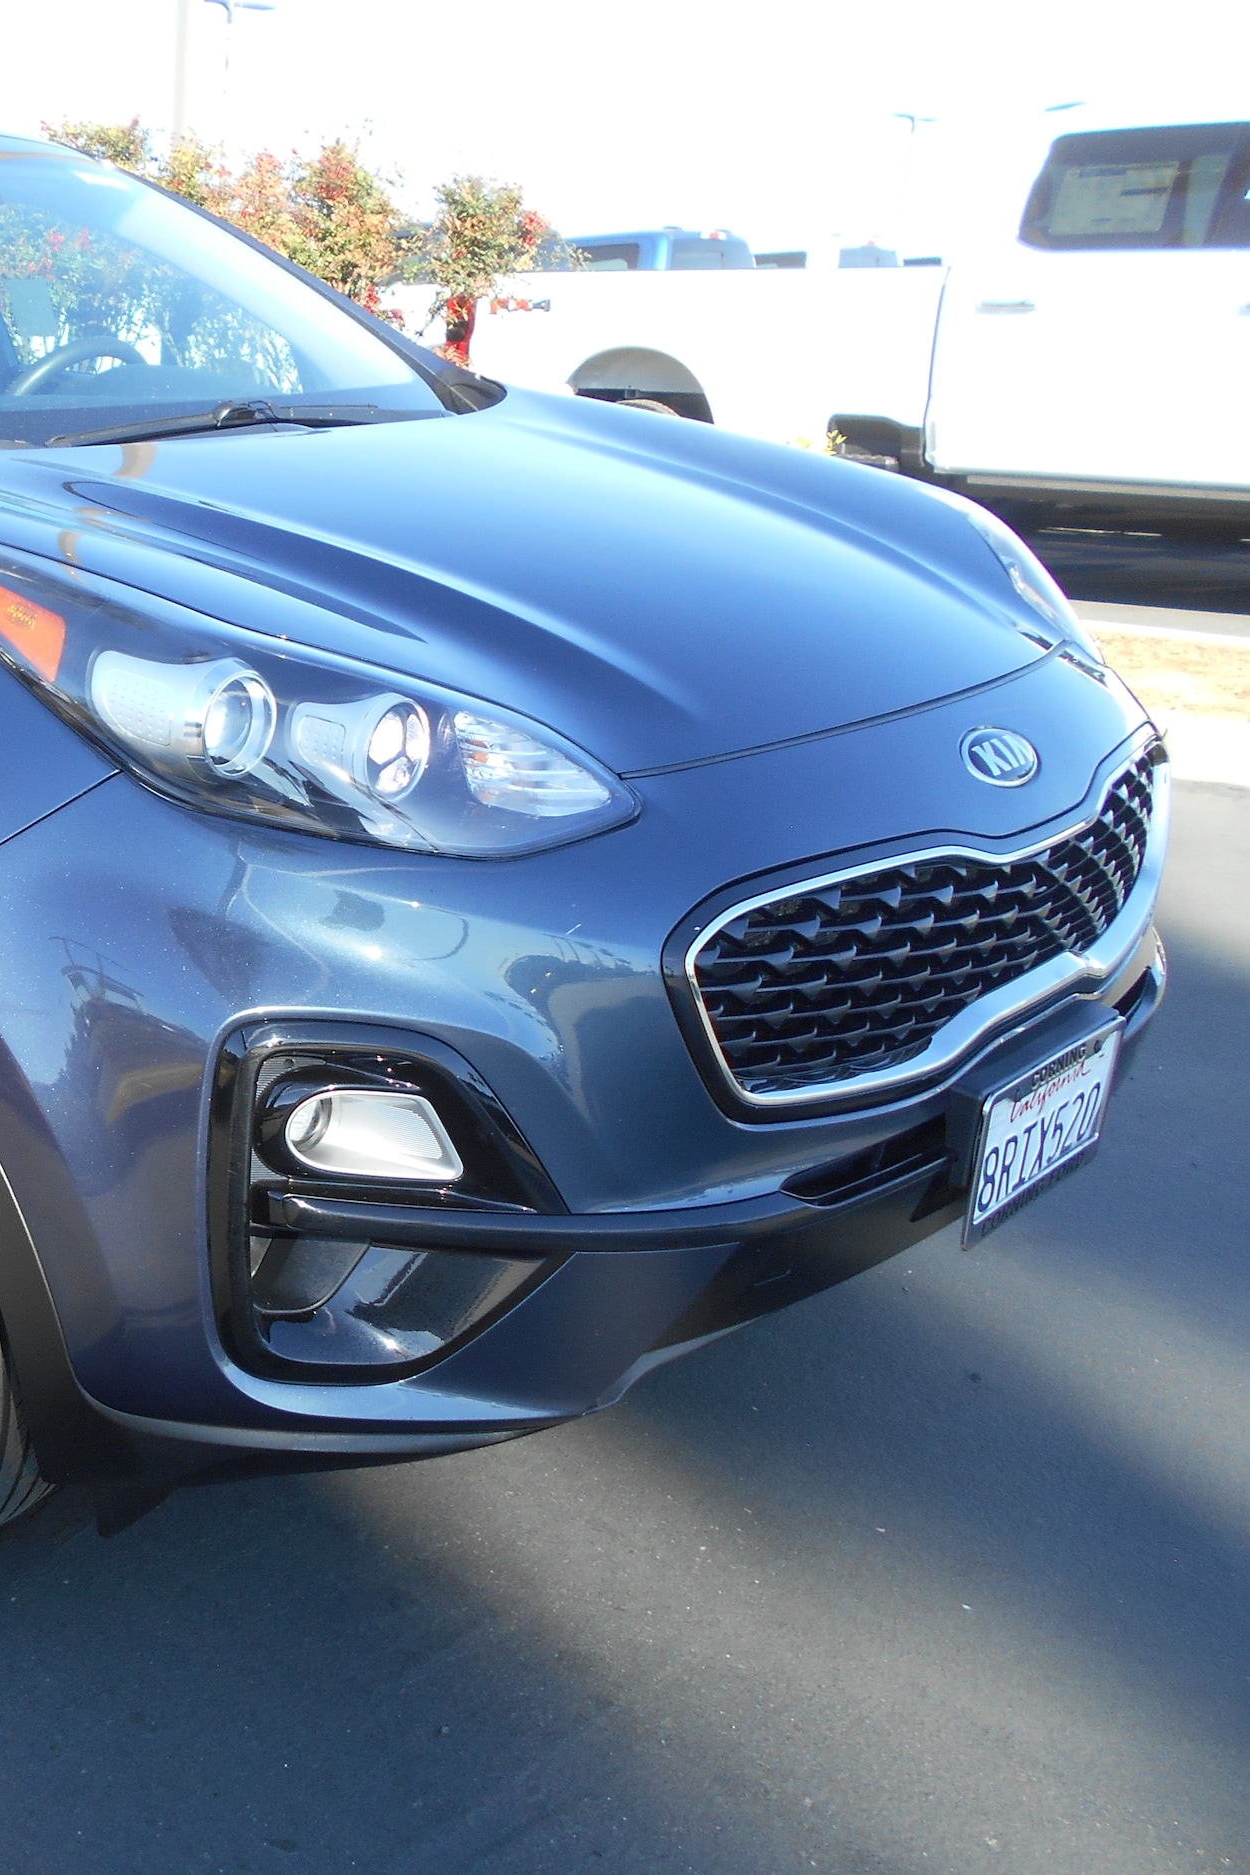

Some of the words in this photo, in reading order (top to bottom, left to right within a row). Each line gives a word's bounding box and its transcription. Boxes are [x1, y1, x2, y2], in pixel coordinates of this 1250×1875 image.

[971, 735, 1034, 776] KIA
[1032, 1042, 1086, 1090] CORNING
[977, 1082, 1101, 1212] 8RIX520
